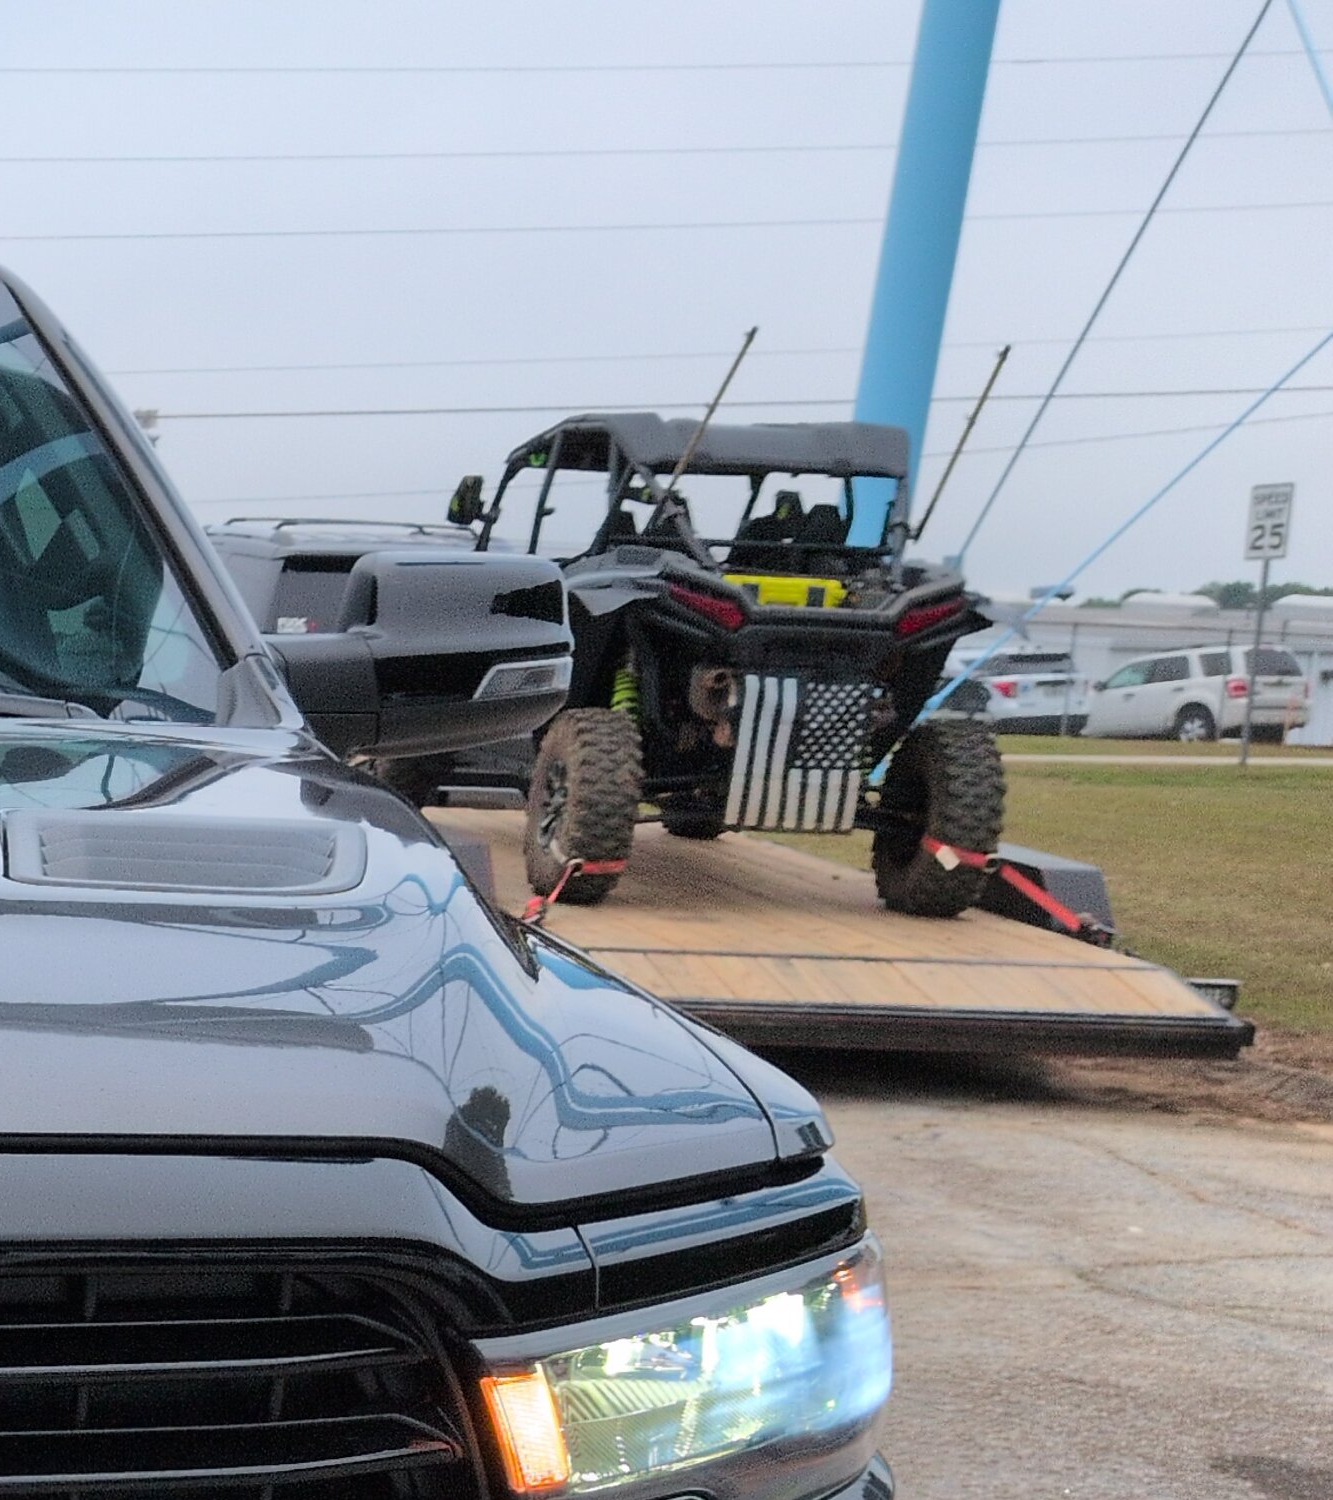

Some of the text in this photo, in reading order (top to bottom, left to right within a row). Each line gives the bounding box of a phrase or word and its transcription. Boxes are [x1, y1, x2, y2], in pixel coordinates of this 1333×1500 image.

[1253, 492, 1289, 504] SPEED
[1255, 507, 1284, 520] LIMIT
[1249, 523, 1285, 550] 25
